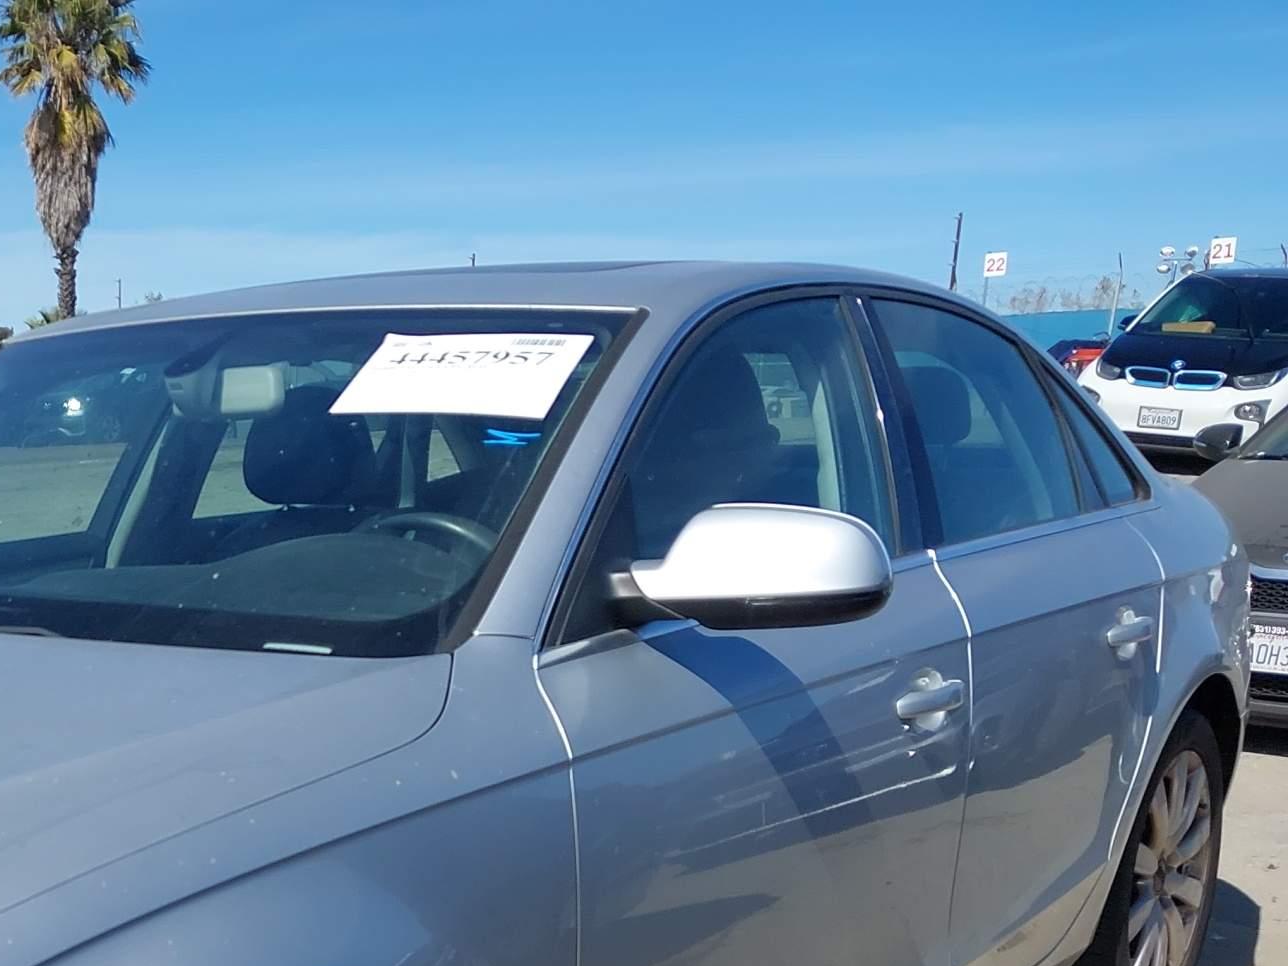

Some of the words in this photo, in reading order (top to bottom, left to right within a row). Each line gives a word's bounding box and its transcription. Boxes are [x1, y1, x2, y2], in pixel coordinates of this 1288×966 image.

[1212, 242, 1233, 259] 21
[986, 257, 1005, 272] 22
[391, 352, 555, 365] 44457957
